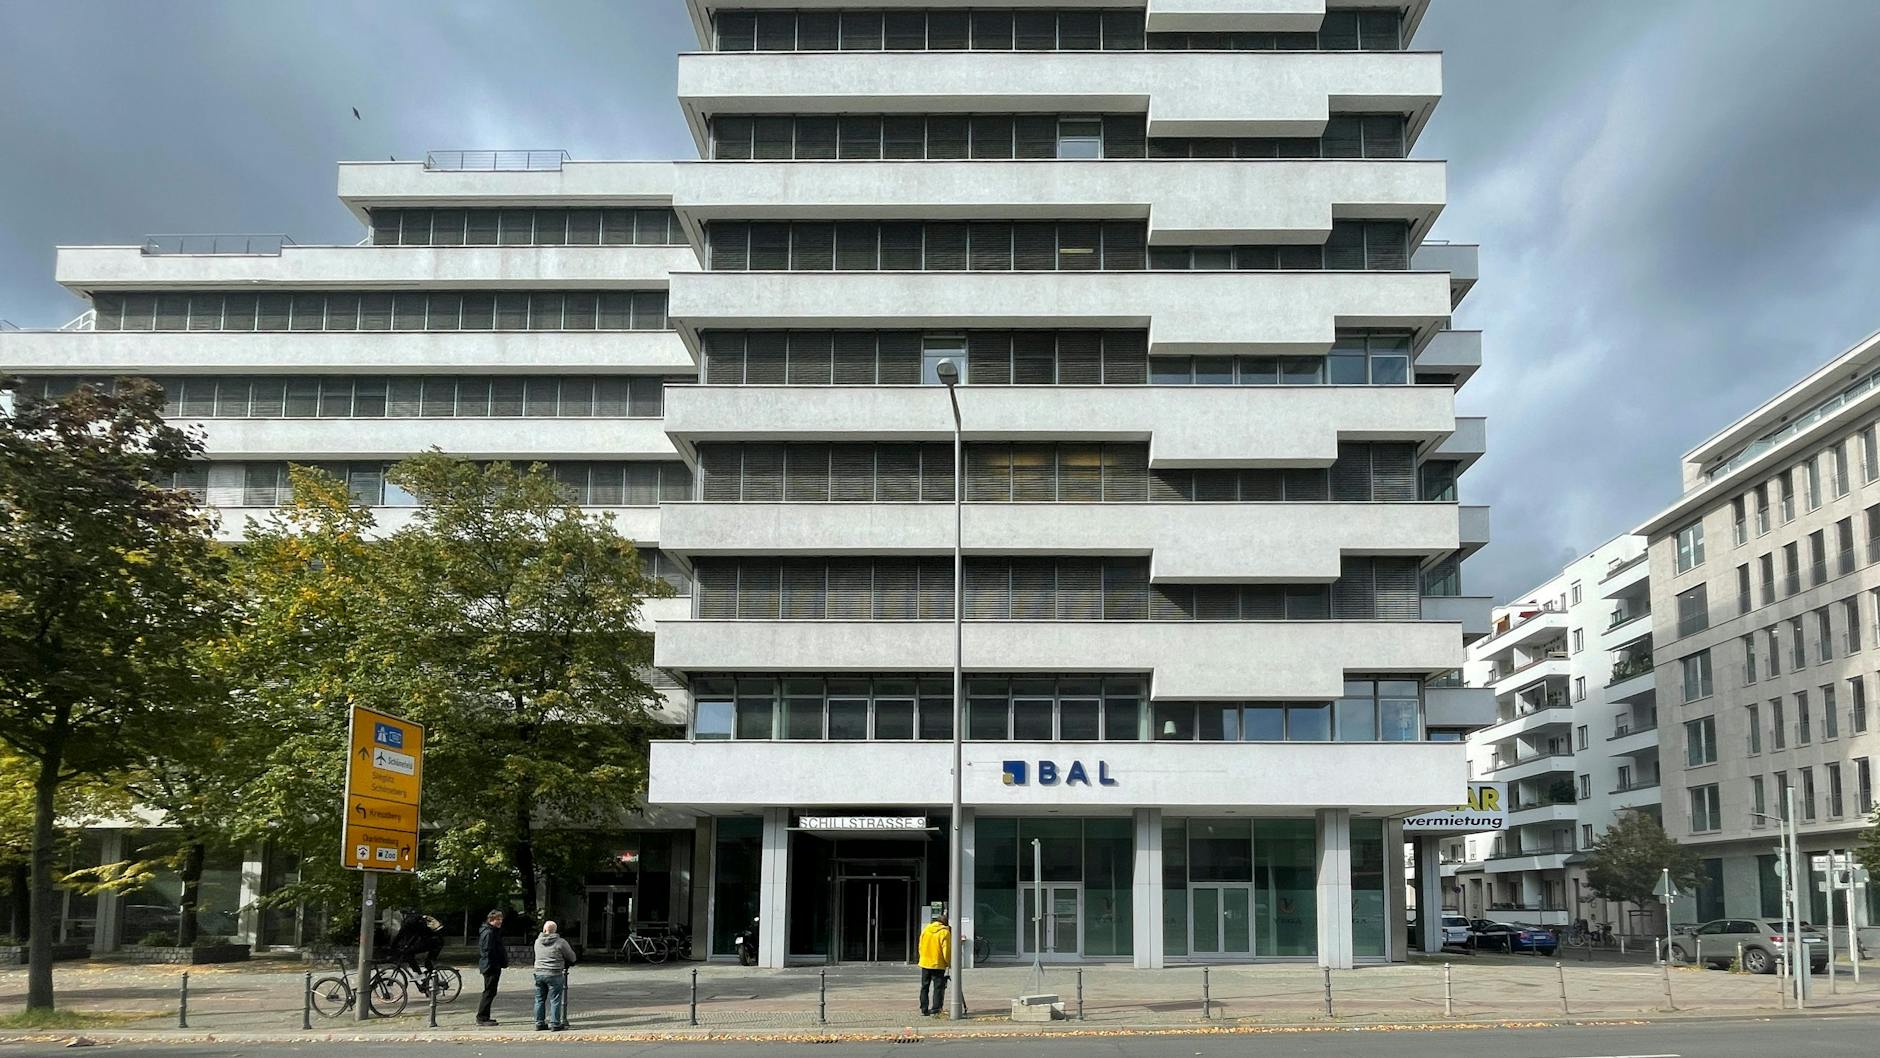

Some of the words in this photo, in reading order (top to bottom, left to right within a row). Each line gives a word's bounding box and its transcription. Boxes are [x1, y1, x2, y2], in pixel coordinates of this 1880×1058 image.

[1039, 760, 1115, 785] BAL
[1447, 786, 1502, 811] AR
[800, 818, 913, 829] SCHILLSTRASSE
[917, 818, 926, 829] 9
[384, 850, 396, 859] Zoo
